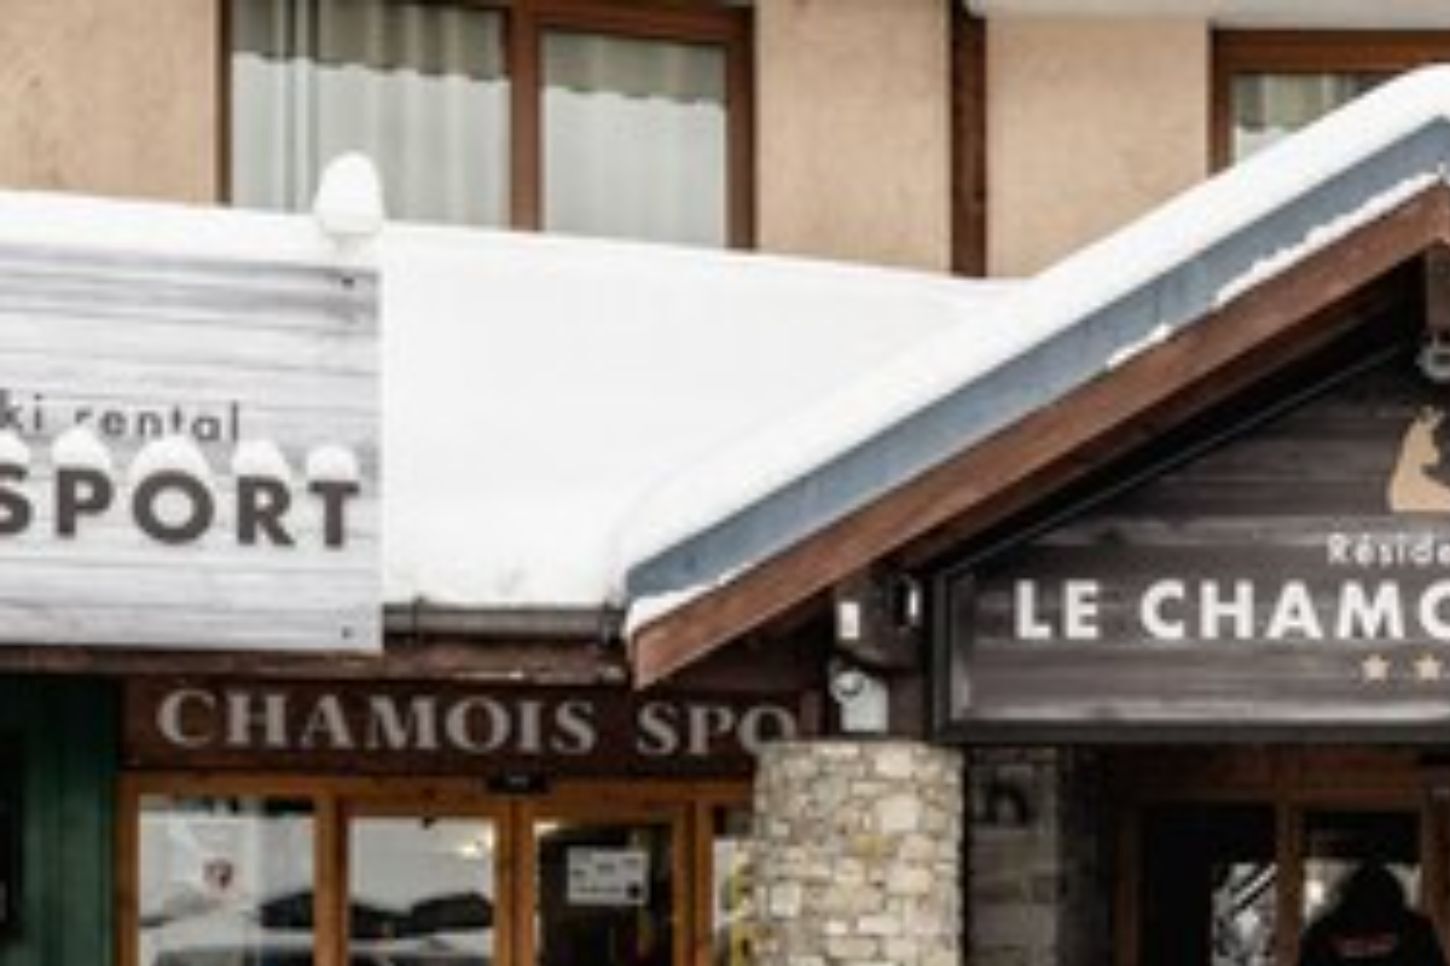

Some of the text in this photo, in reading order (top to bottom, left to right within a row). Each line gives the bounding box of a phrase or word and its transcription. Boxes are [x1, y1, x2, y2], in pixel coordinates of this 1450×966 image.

[74, 399, 240, 441] rental
[1013, 578, 1100, 640] LE
[156, 688, 598, 756] CHAMOIS
